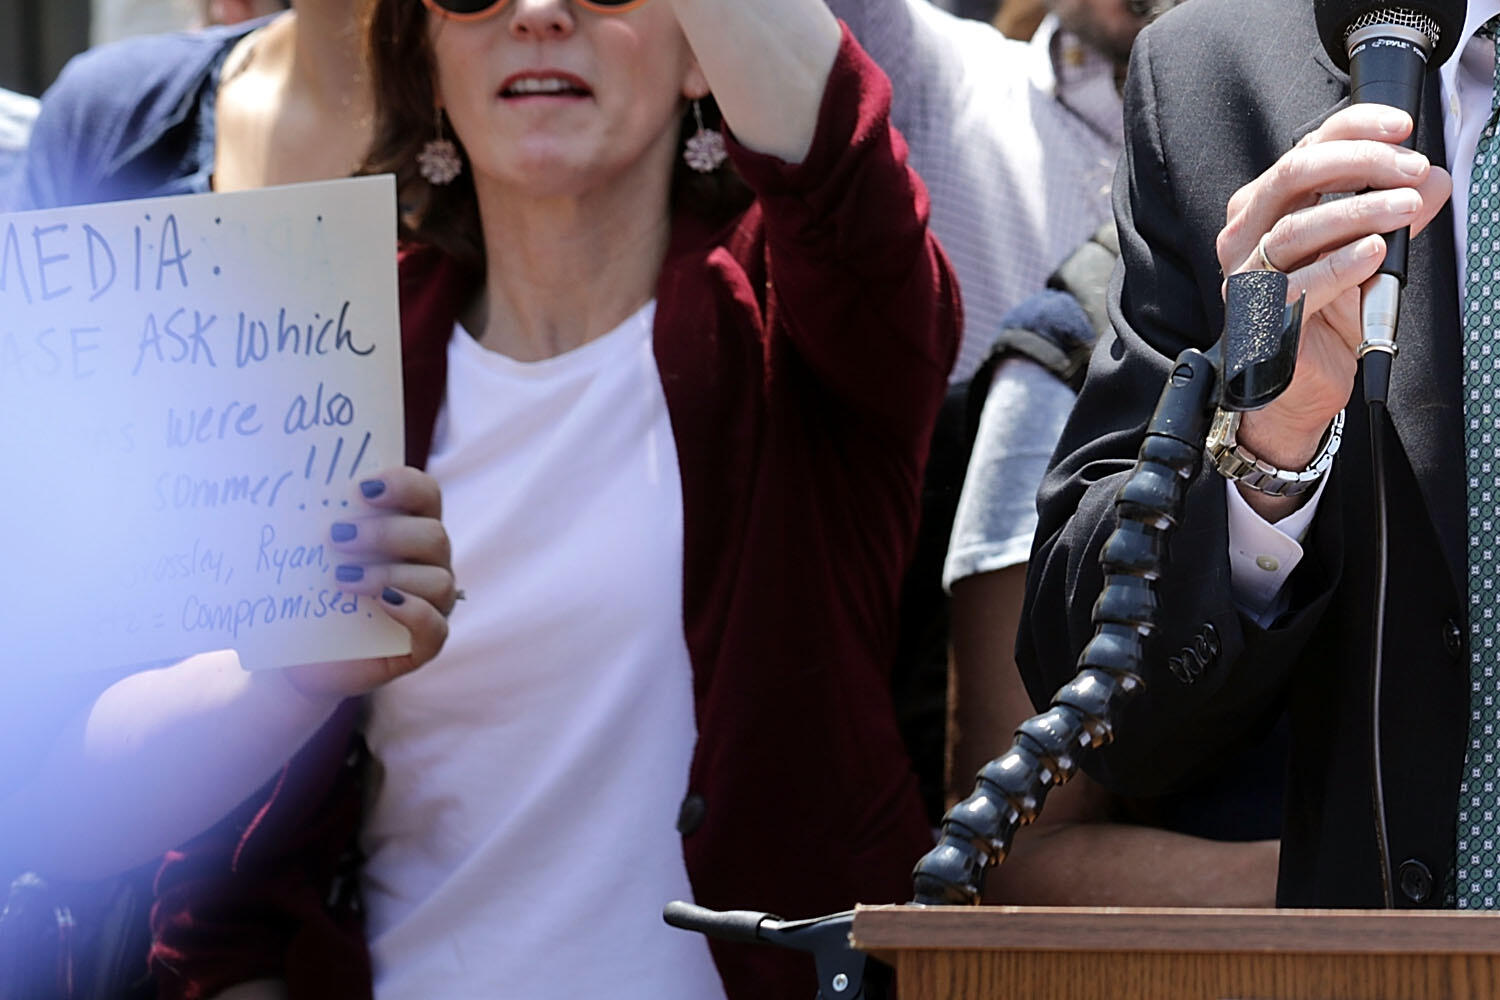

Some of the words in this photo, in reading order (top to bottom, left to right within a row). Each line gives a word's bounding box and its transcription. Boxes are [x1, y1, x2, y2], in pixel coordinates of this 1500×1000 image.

[132, 307, 218, 377] ASK
[167, 400, 263, 449] were
[284, 381, 354, 435] also
[256, 523, 329, 585] Ryan,
